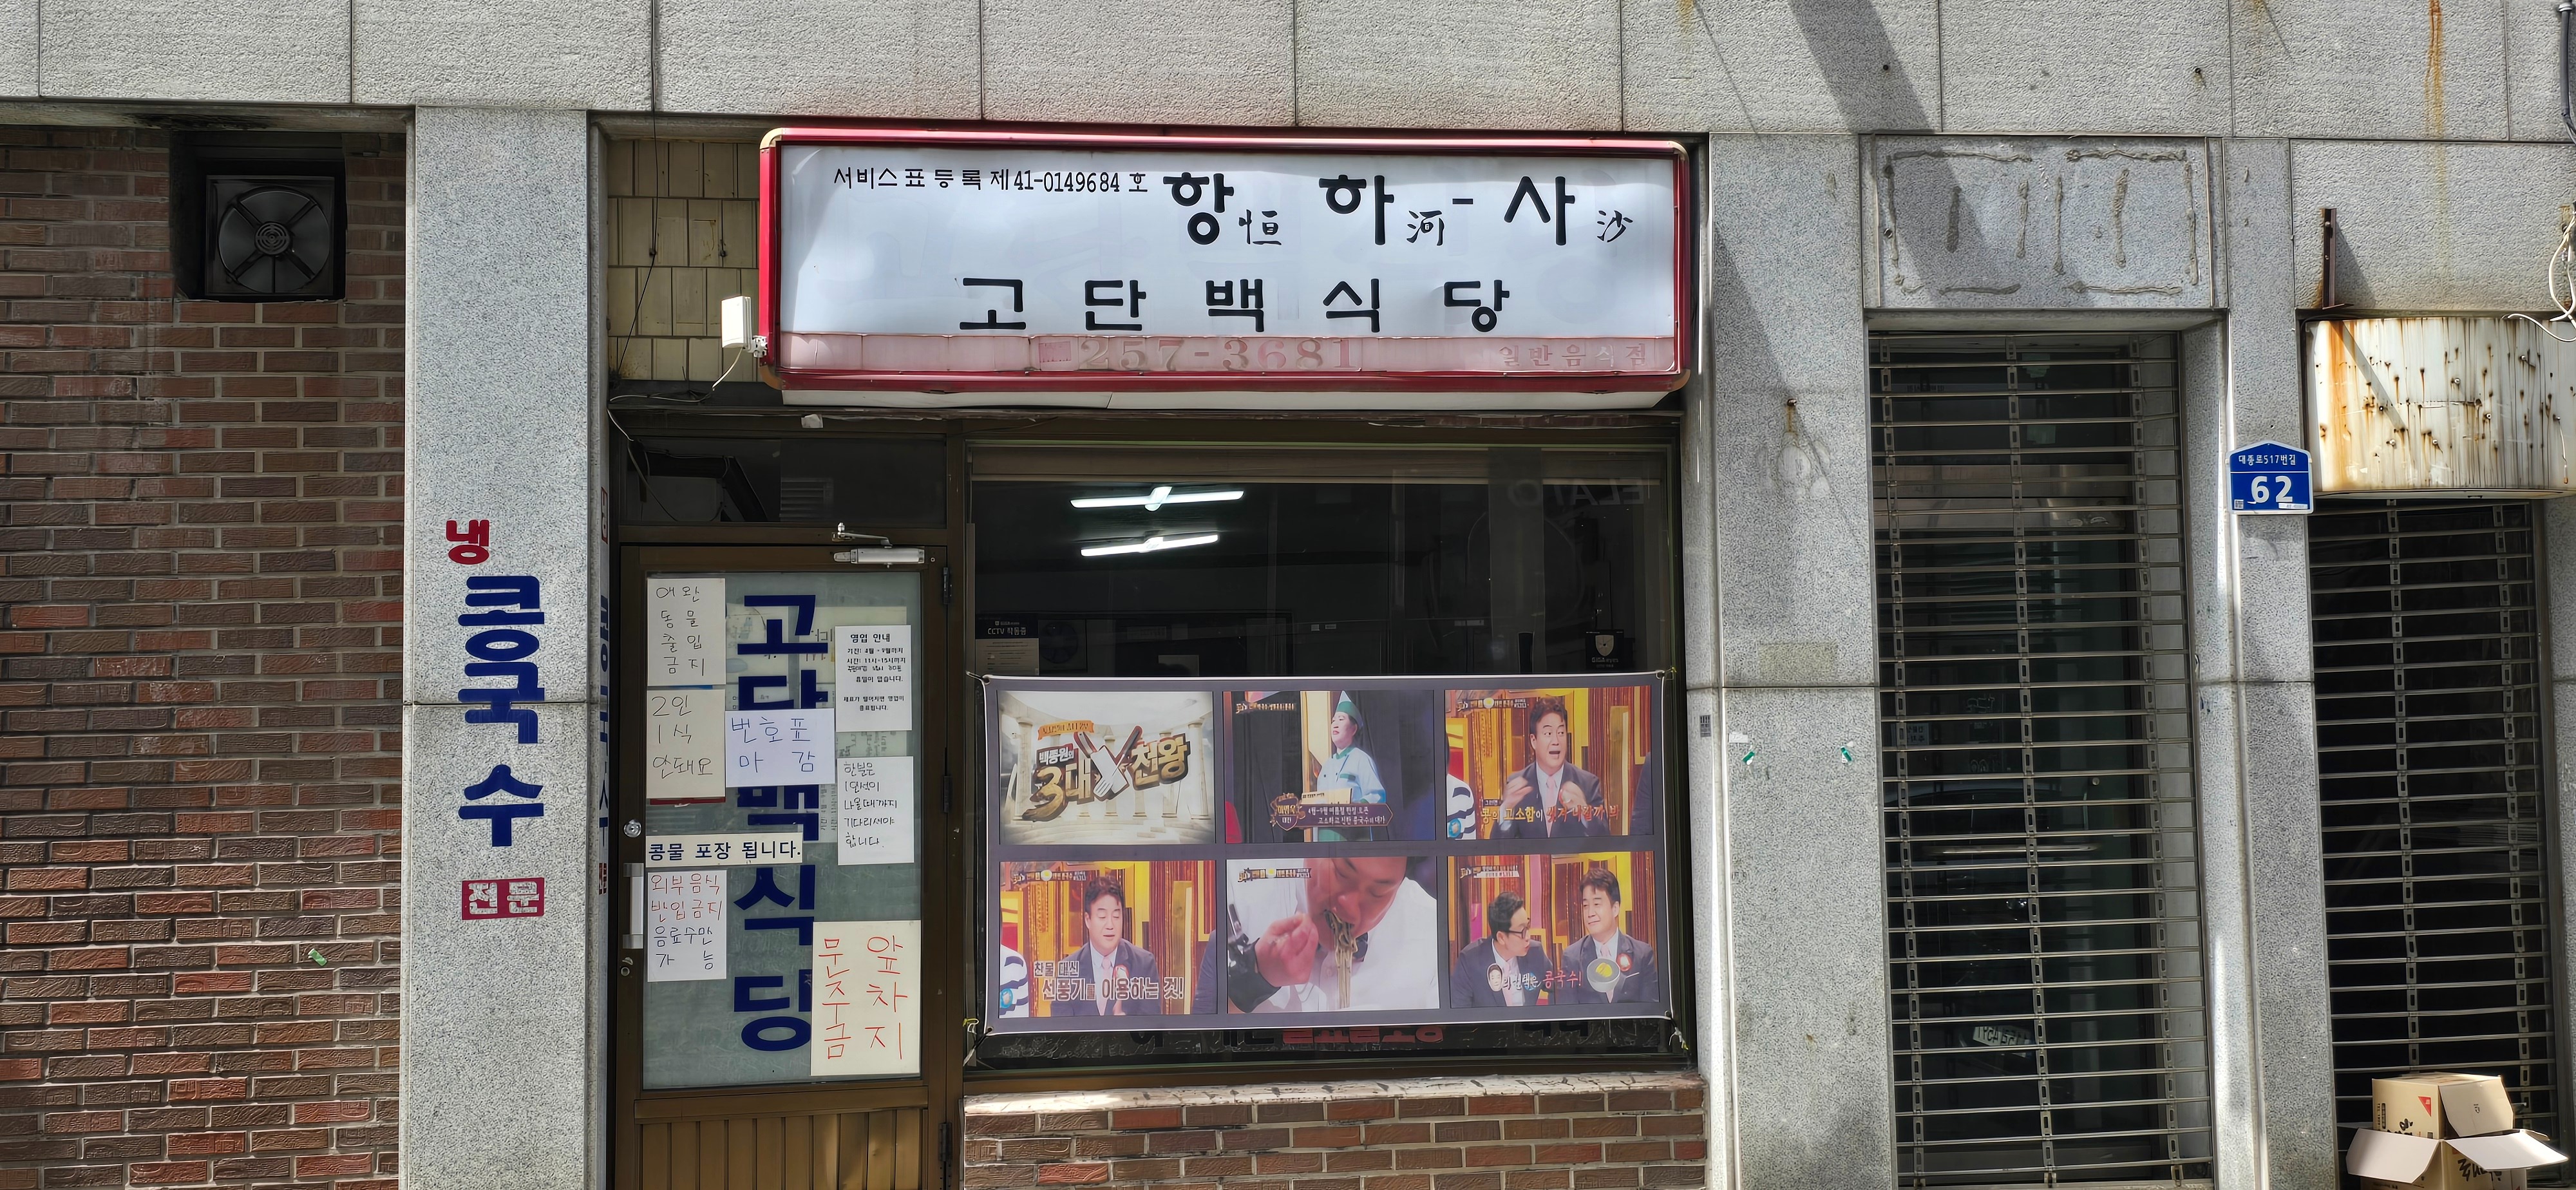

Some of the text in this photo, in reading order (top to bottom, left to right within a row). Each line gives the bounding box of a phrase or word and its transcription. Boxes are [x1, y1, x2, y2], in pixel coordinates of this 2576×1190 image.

[834, 167, 926, 190] 서비스표
[934, 168, 982, 191] 등록
[1128, 171, 1148, 193] 호
[959, 278, 1510, 334] 고단백식당
[1081, 339, 1358, 372] 257-3681
[2251, 475, 2293, 504] 62
[446, 519, 489, 565] 냉
[458, 575, 545, 847] 콩국수
[651, 695, 692, 717] 2인
[731, 716, 811, 744] 번호표
[648, 840, 802, 862] 콩물 포장 됩니다.
[468, 880, 541, 917] 전문
[1101, 976, 1159, 1000] 이용하는
